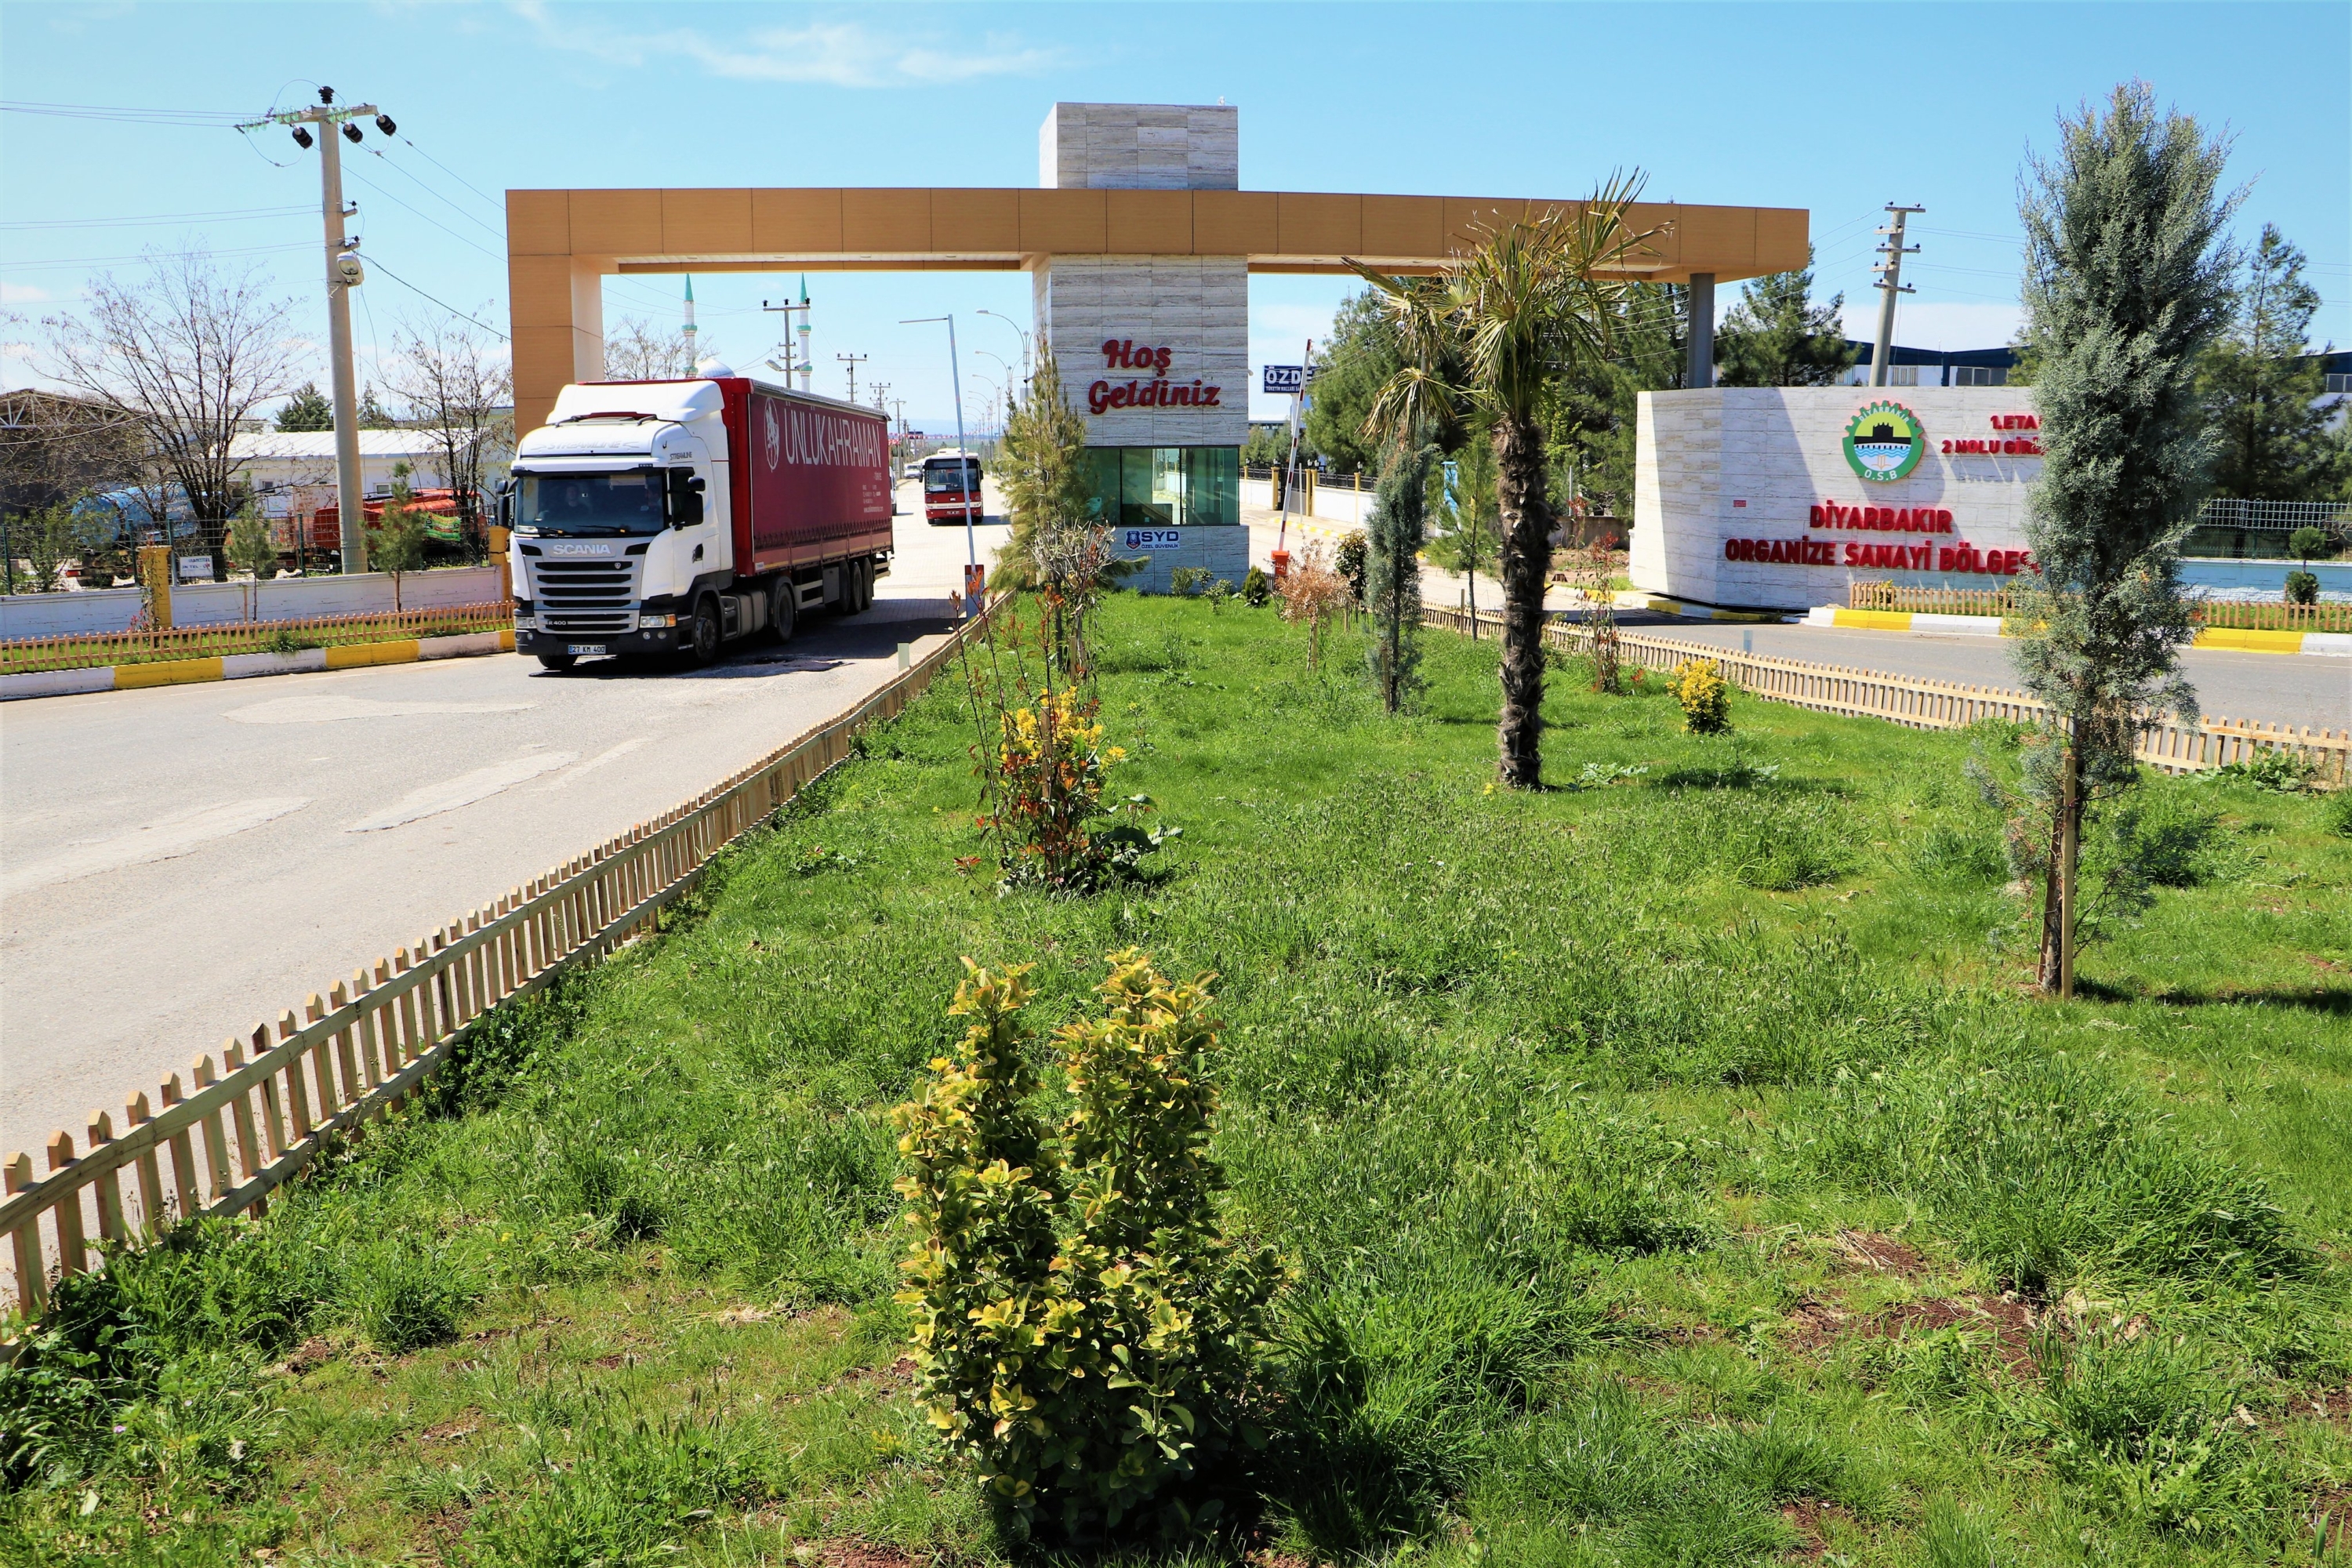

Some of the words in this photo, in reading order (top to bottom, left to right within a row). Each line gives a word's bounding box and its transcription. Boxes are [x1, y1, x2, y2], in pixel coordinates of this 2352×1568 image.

[1102, 339, 1171, 377] Hoş
[1088, 379, 1221, 415] Geldiniz
[1858, 406, 1910, 423] DİYARBAKIR
[784, 401, 881, 468] ÜNLÜKAHRAMAN
[547, 441, 622, 450] STREAMLINE
[1941, 440, 1952, 454] 2
[1955, 440, 2001, 454] NOLU
[670, 452, 693, 461] STREAMLINE
[1864, 469, 1897, 481] O.S.B
[1809, 499, 1953, 534] DİYARBAKIR
[1141, 531, 1179, 543] SYD
[553, 544, 612, 555] SCANIA
[1725, 535, 1837, 566] ORGANİZE
[1844, 540, 1933, 571] SANAYİ
